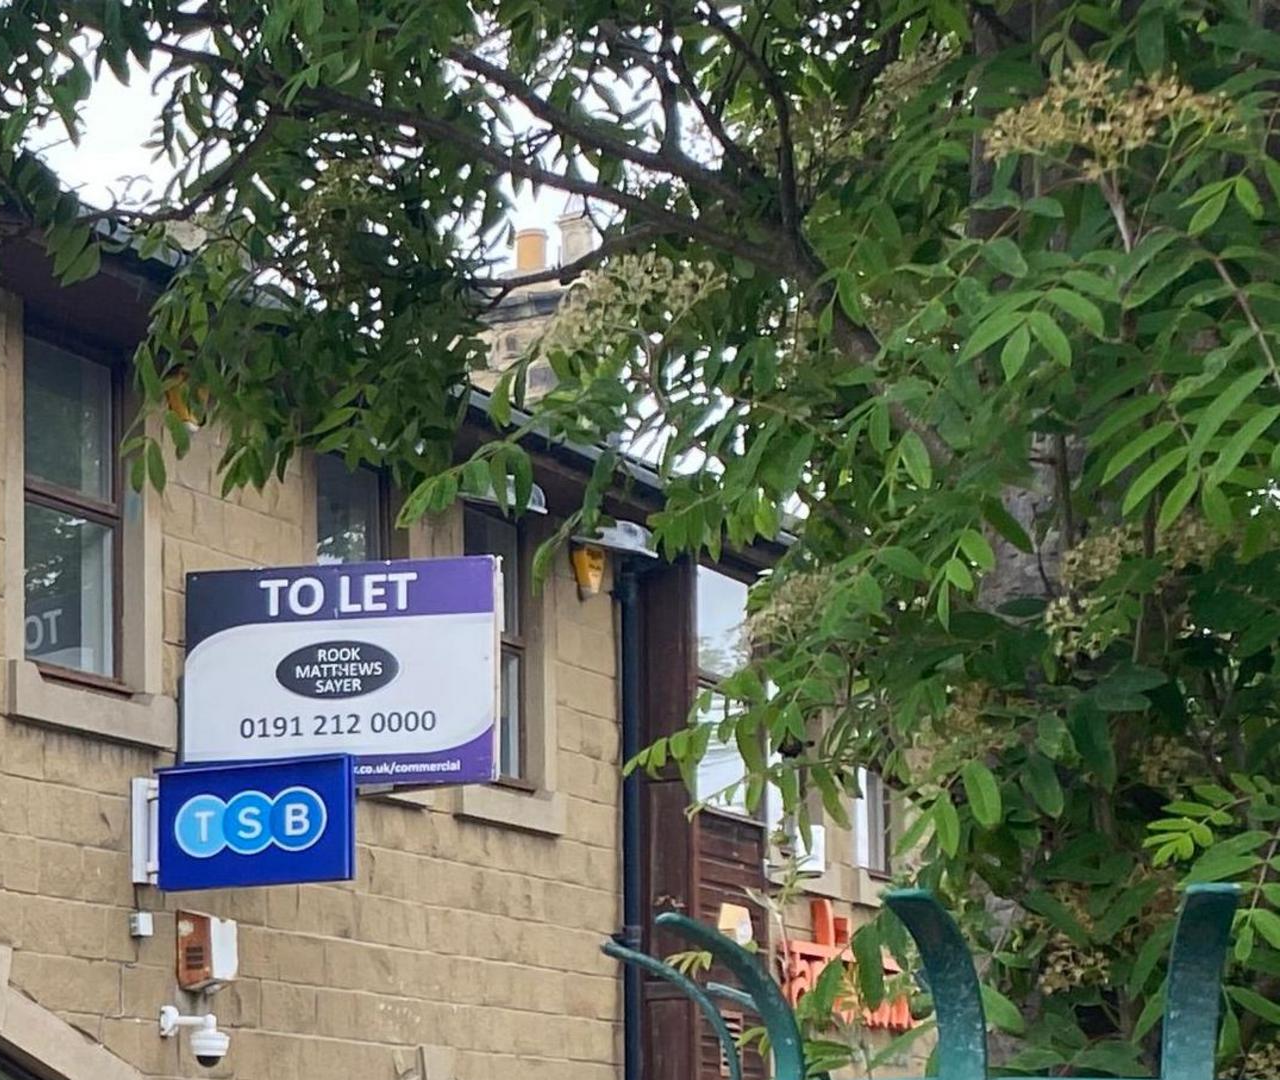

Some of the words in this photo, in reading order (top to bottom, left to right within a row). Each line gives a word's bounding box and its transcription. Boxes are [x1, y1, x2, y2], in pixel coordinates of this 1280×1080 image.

[259, 576, 325, 617] TO
[340, 572, 418, 613] LET
[317, 647, 361, 662] ROOK
[295, 662, 383, 679] MATTHEWS
[315, 678, 362, 694] SAYER
[240, 716, 303, 739] 0191
[313, 714, 361, 736] 212
[370, 710, 437, 733] 0000
[194, 803, 310, 843] TSB
